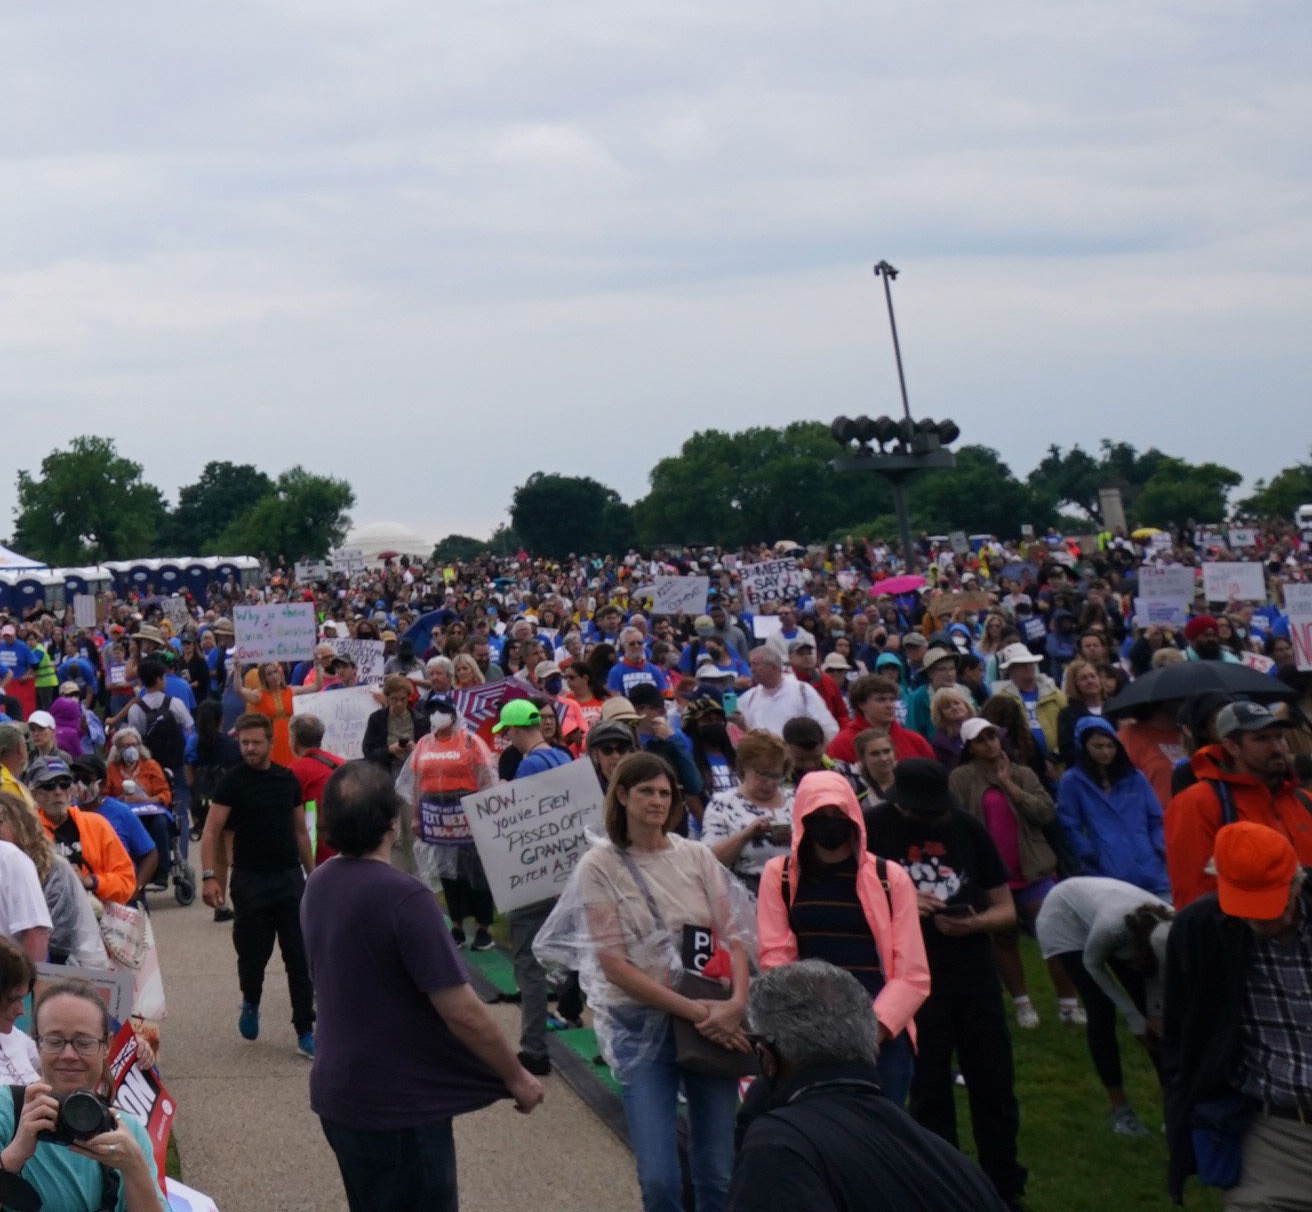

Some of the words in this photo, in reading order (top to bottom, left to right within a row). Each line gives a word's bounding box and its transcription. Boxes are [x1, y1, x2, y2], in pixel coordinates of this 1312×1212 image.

[755, 575, 778, 590] SAY
[235, 611, 261, 625] Why
[520, 833, 589, 865] GRANDM
